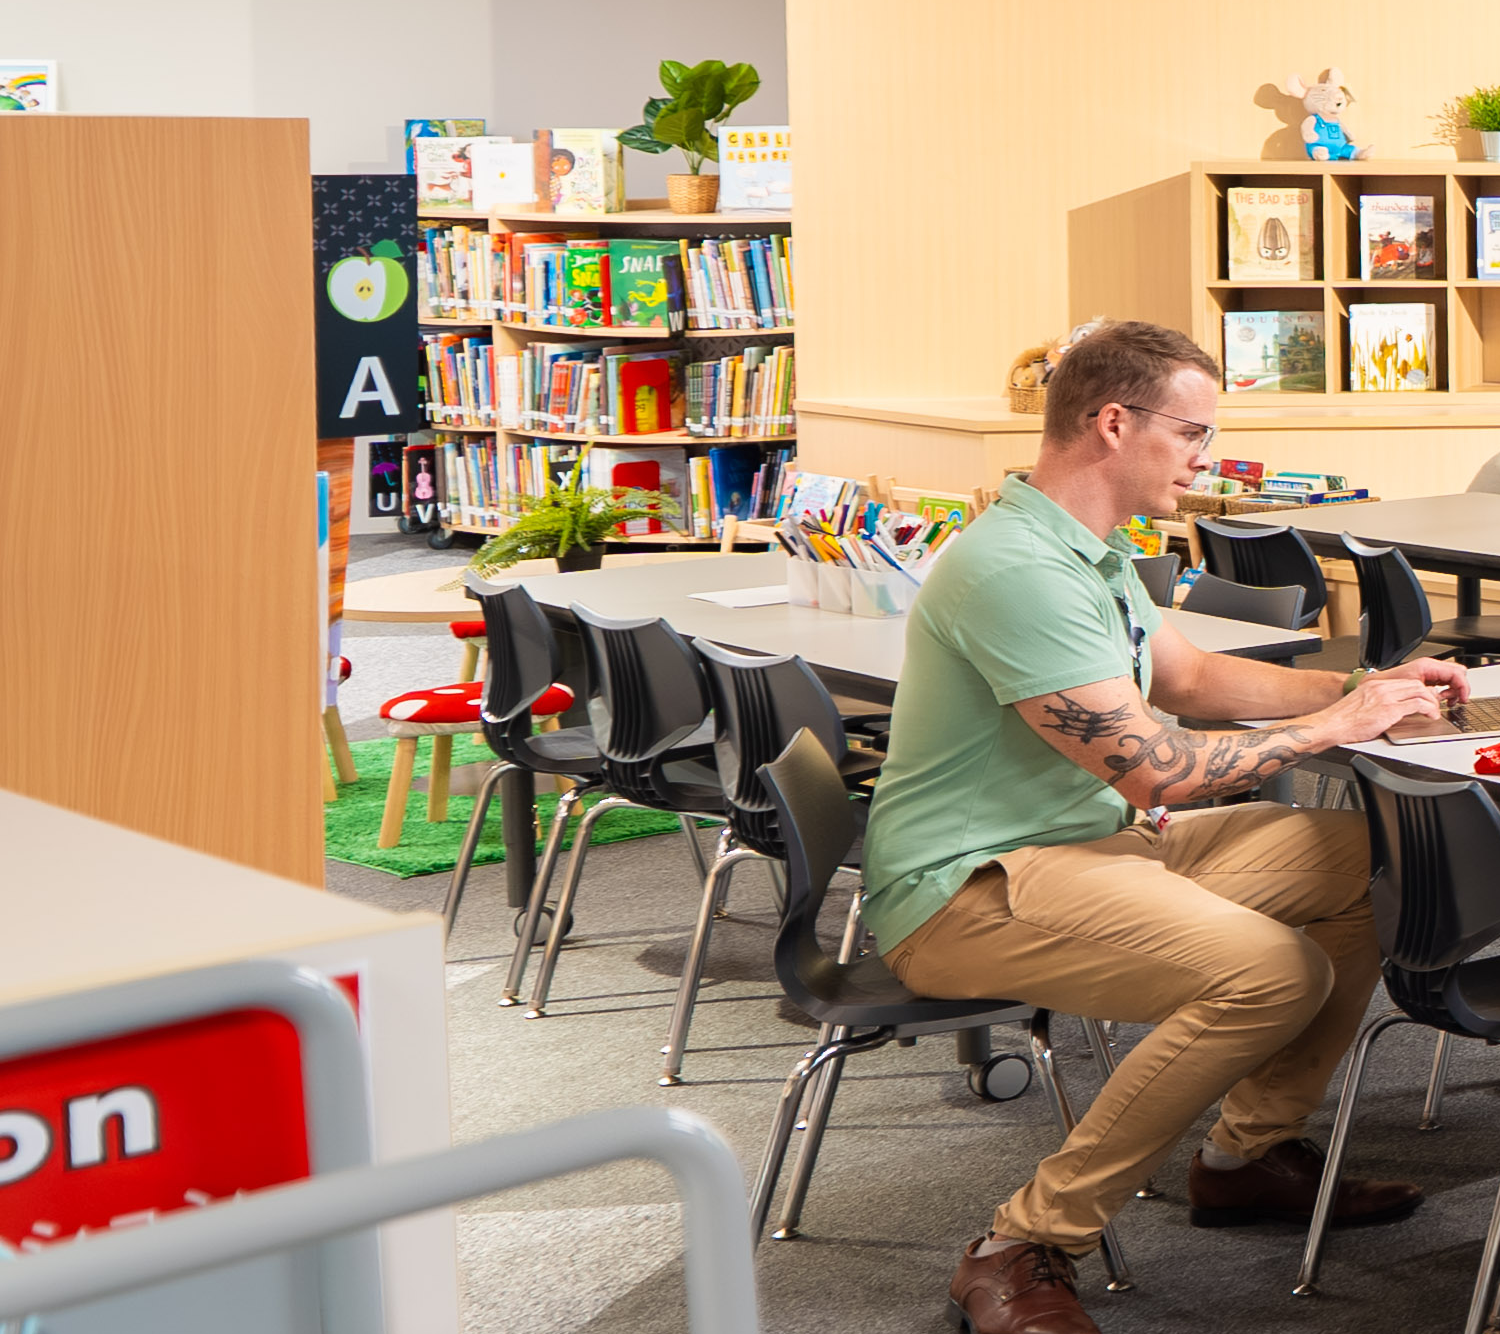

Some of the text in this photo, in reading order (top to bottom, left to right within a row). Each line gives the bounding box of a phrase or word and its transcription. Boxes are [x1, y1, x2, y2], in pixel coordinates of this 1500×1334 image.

[1234, 192, 1309, 206] THE BAD SEED
[669, 310, 684, 332] W
[1237, 315, 1315, 324] JOURNEY
[339, 355, 400, 419] A
[377, 492, 397, 513] U
[414, 503, 435, 524] V
